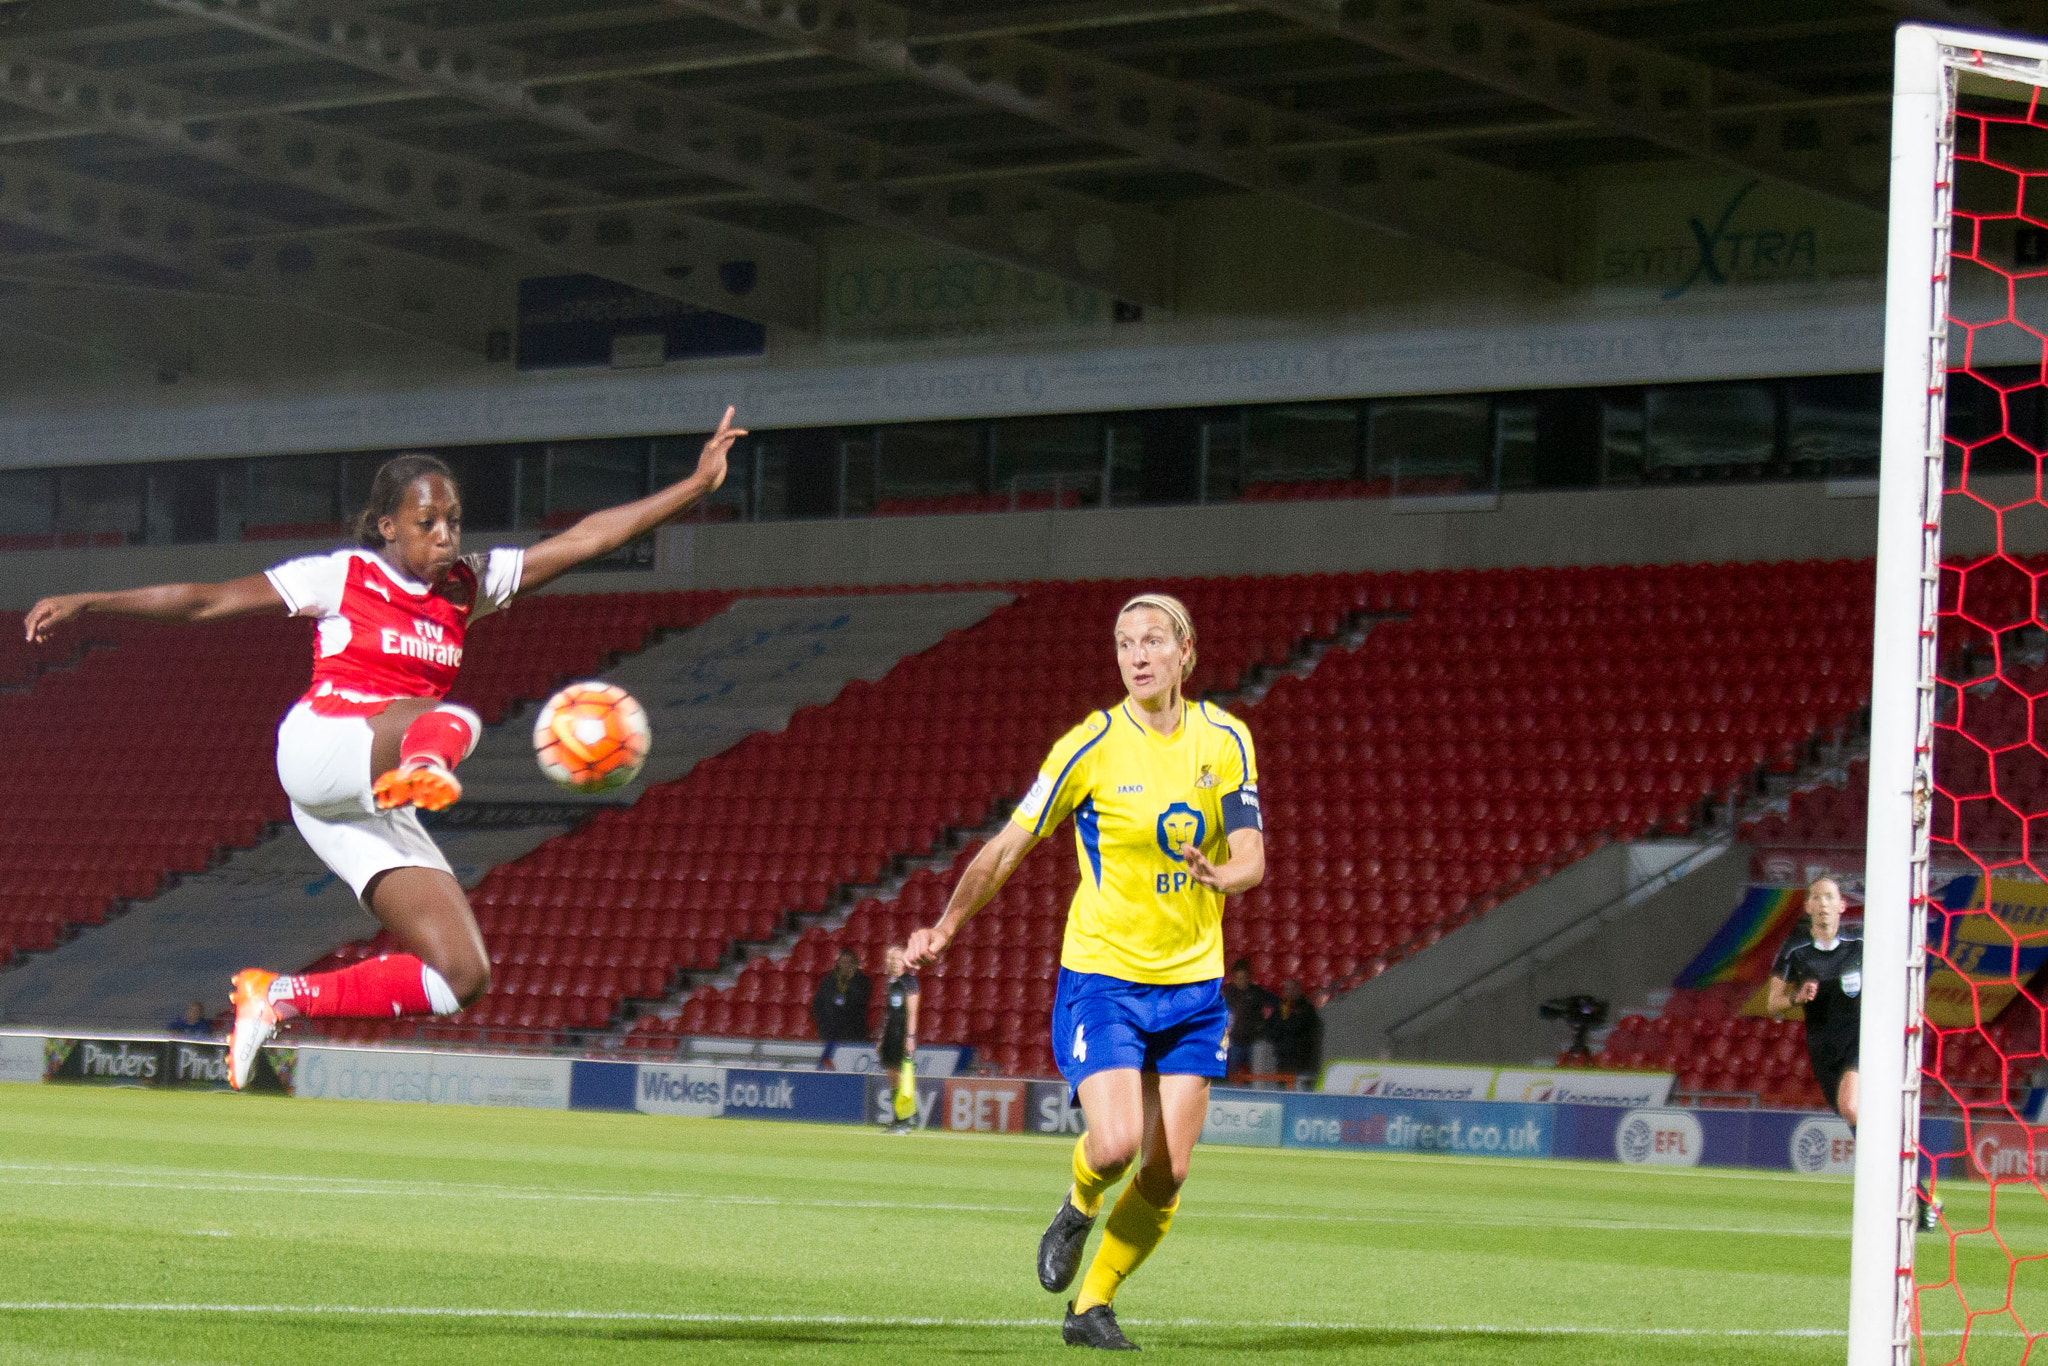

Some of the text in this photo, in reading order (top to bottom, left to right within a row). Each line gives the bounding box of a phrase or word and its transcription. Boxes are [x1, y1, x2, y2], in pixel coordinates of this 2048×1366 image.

[381, 628, 462, 668] Emirate
[413, 620, 444, 643] Fly
[1116, 783, 1144, 794] JAKO
[1073, 1023, 1087, 1063] 4
[82, 1044, 157, 1078] Pinders
[177, 1047, 231, 1081] Pind
[877, 1088, 1017, 1134] sy BET
[1040, 1089, 1088, 1134] sk
[1654, 1131, 1688, 1156] EFL
[1830, 1138, 1856, 1163] EF
